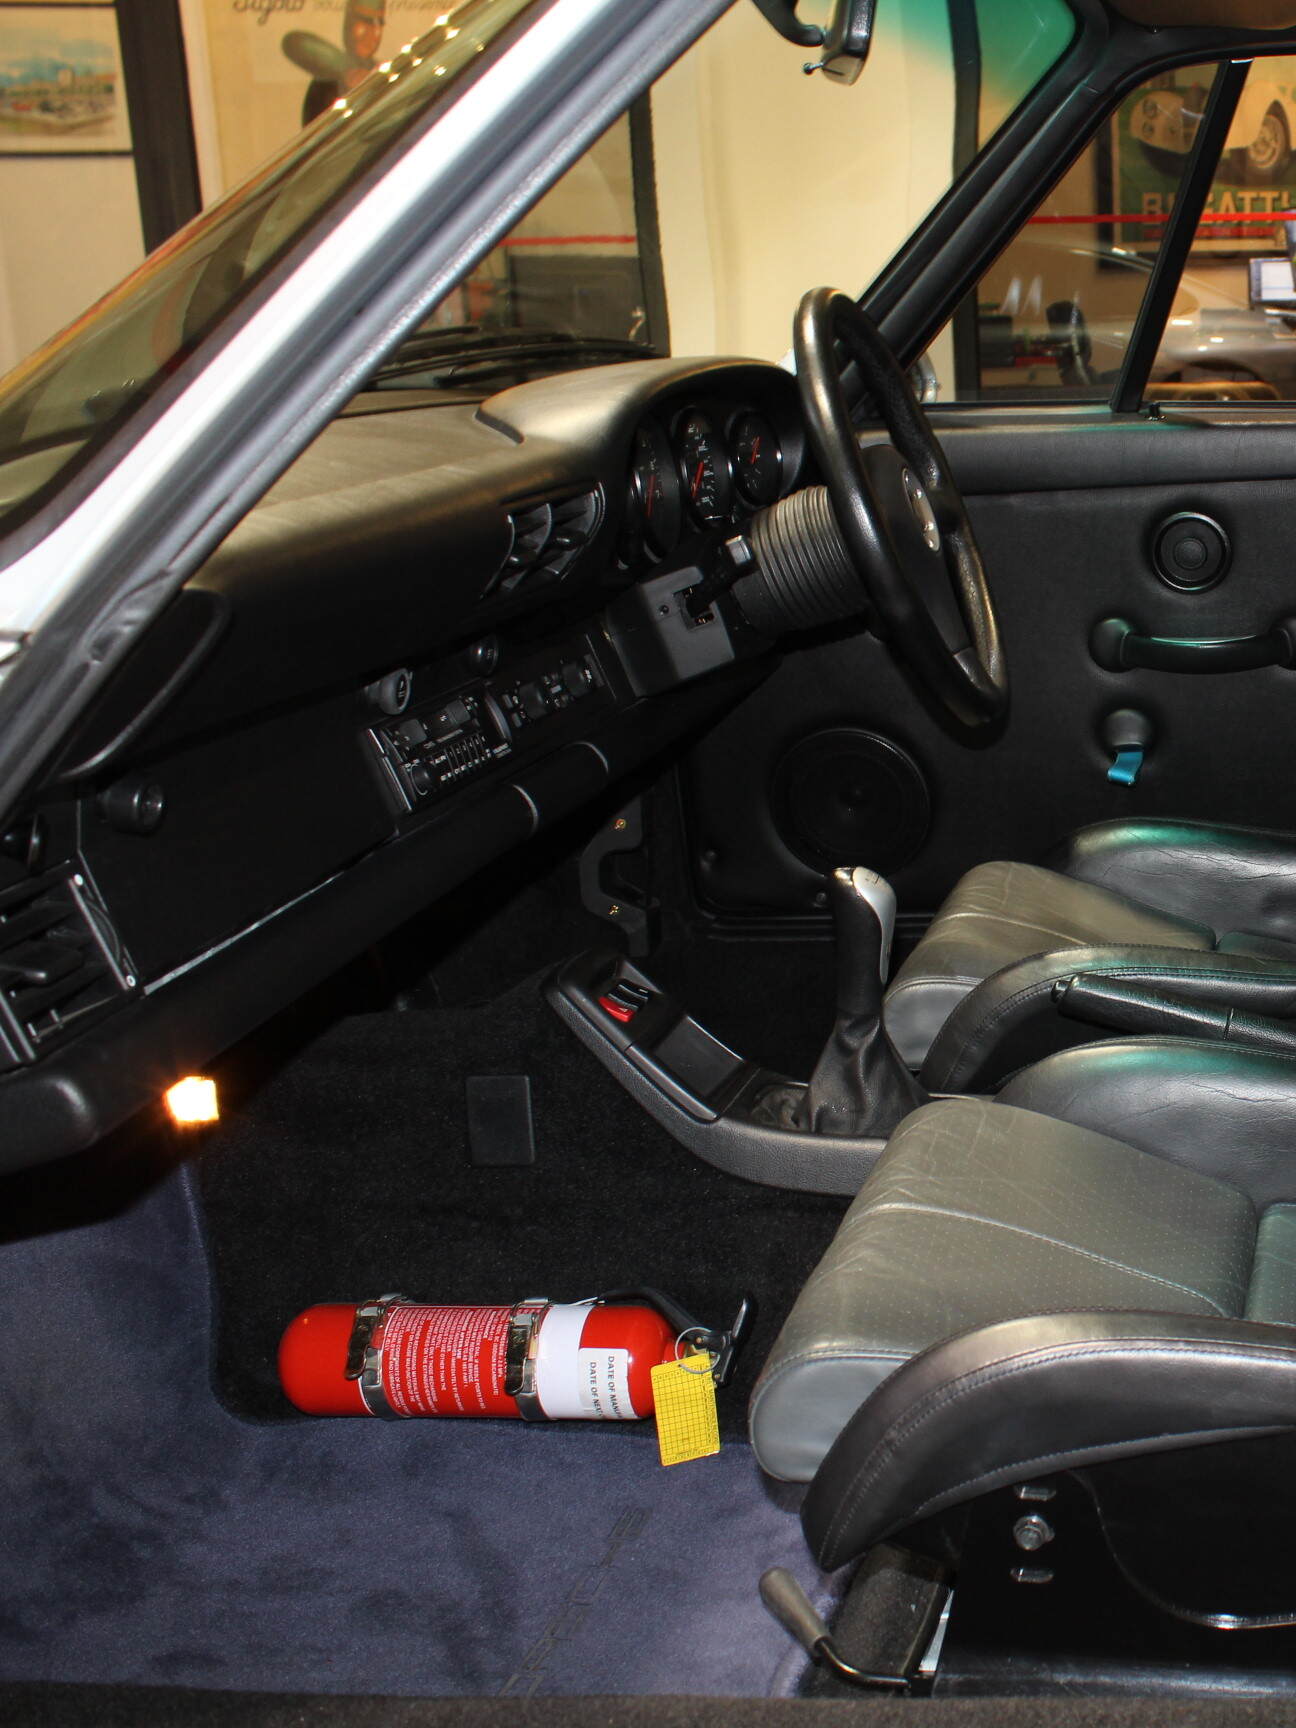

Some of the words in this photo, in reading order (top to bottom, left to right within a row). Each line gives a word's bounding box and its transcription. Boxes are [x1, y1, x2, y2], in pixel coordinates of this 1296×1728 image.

[1142, 190, 1290, 224] BATT
[591, 1387, 599, 1398] OF
[608, 1382, 616, 1393] OF
